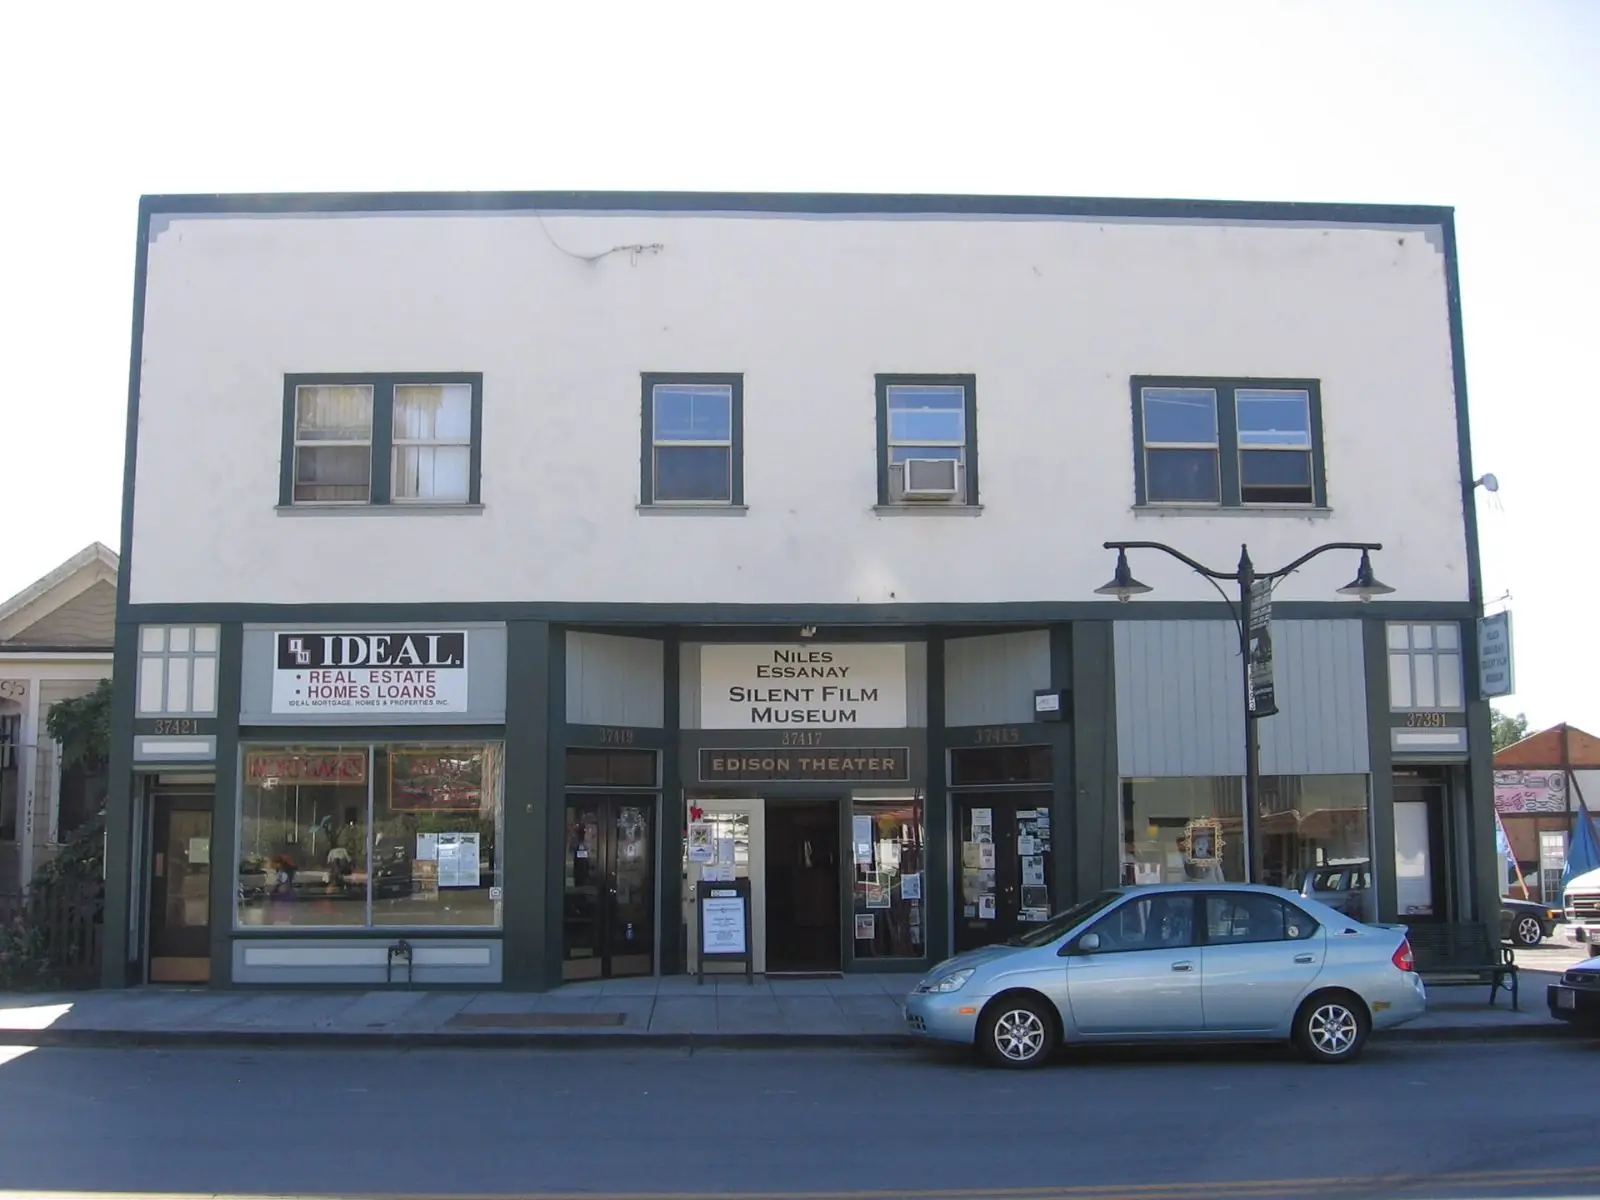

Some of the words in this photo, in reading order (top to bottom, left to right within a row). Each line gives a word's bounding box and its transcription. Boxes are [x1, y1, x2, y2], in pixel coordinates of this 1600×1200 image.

[309, 671, 357, 683] REAL
[369, 670, 436, 683] ESTATE
[756, 665, 850, 678] ESSANAY
[308, 686, 370, 698] HOMES
[377, 685, 436, 698] LOANS
[729, 686, 815, 702] SILENT
[822, 686, 878, 702] FILM
[751, 707, 857, 724] MUSEUM
[1406, 712, 1448, 727] 37391
[154, 720, 199, 734] 37421
[781, 732, 823, 745] 37417
[712, 758, 790, 771] EDISON
[799, 758, 895, 771] THEATER
